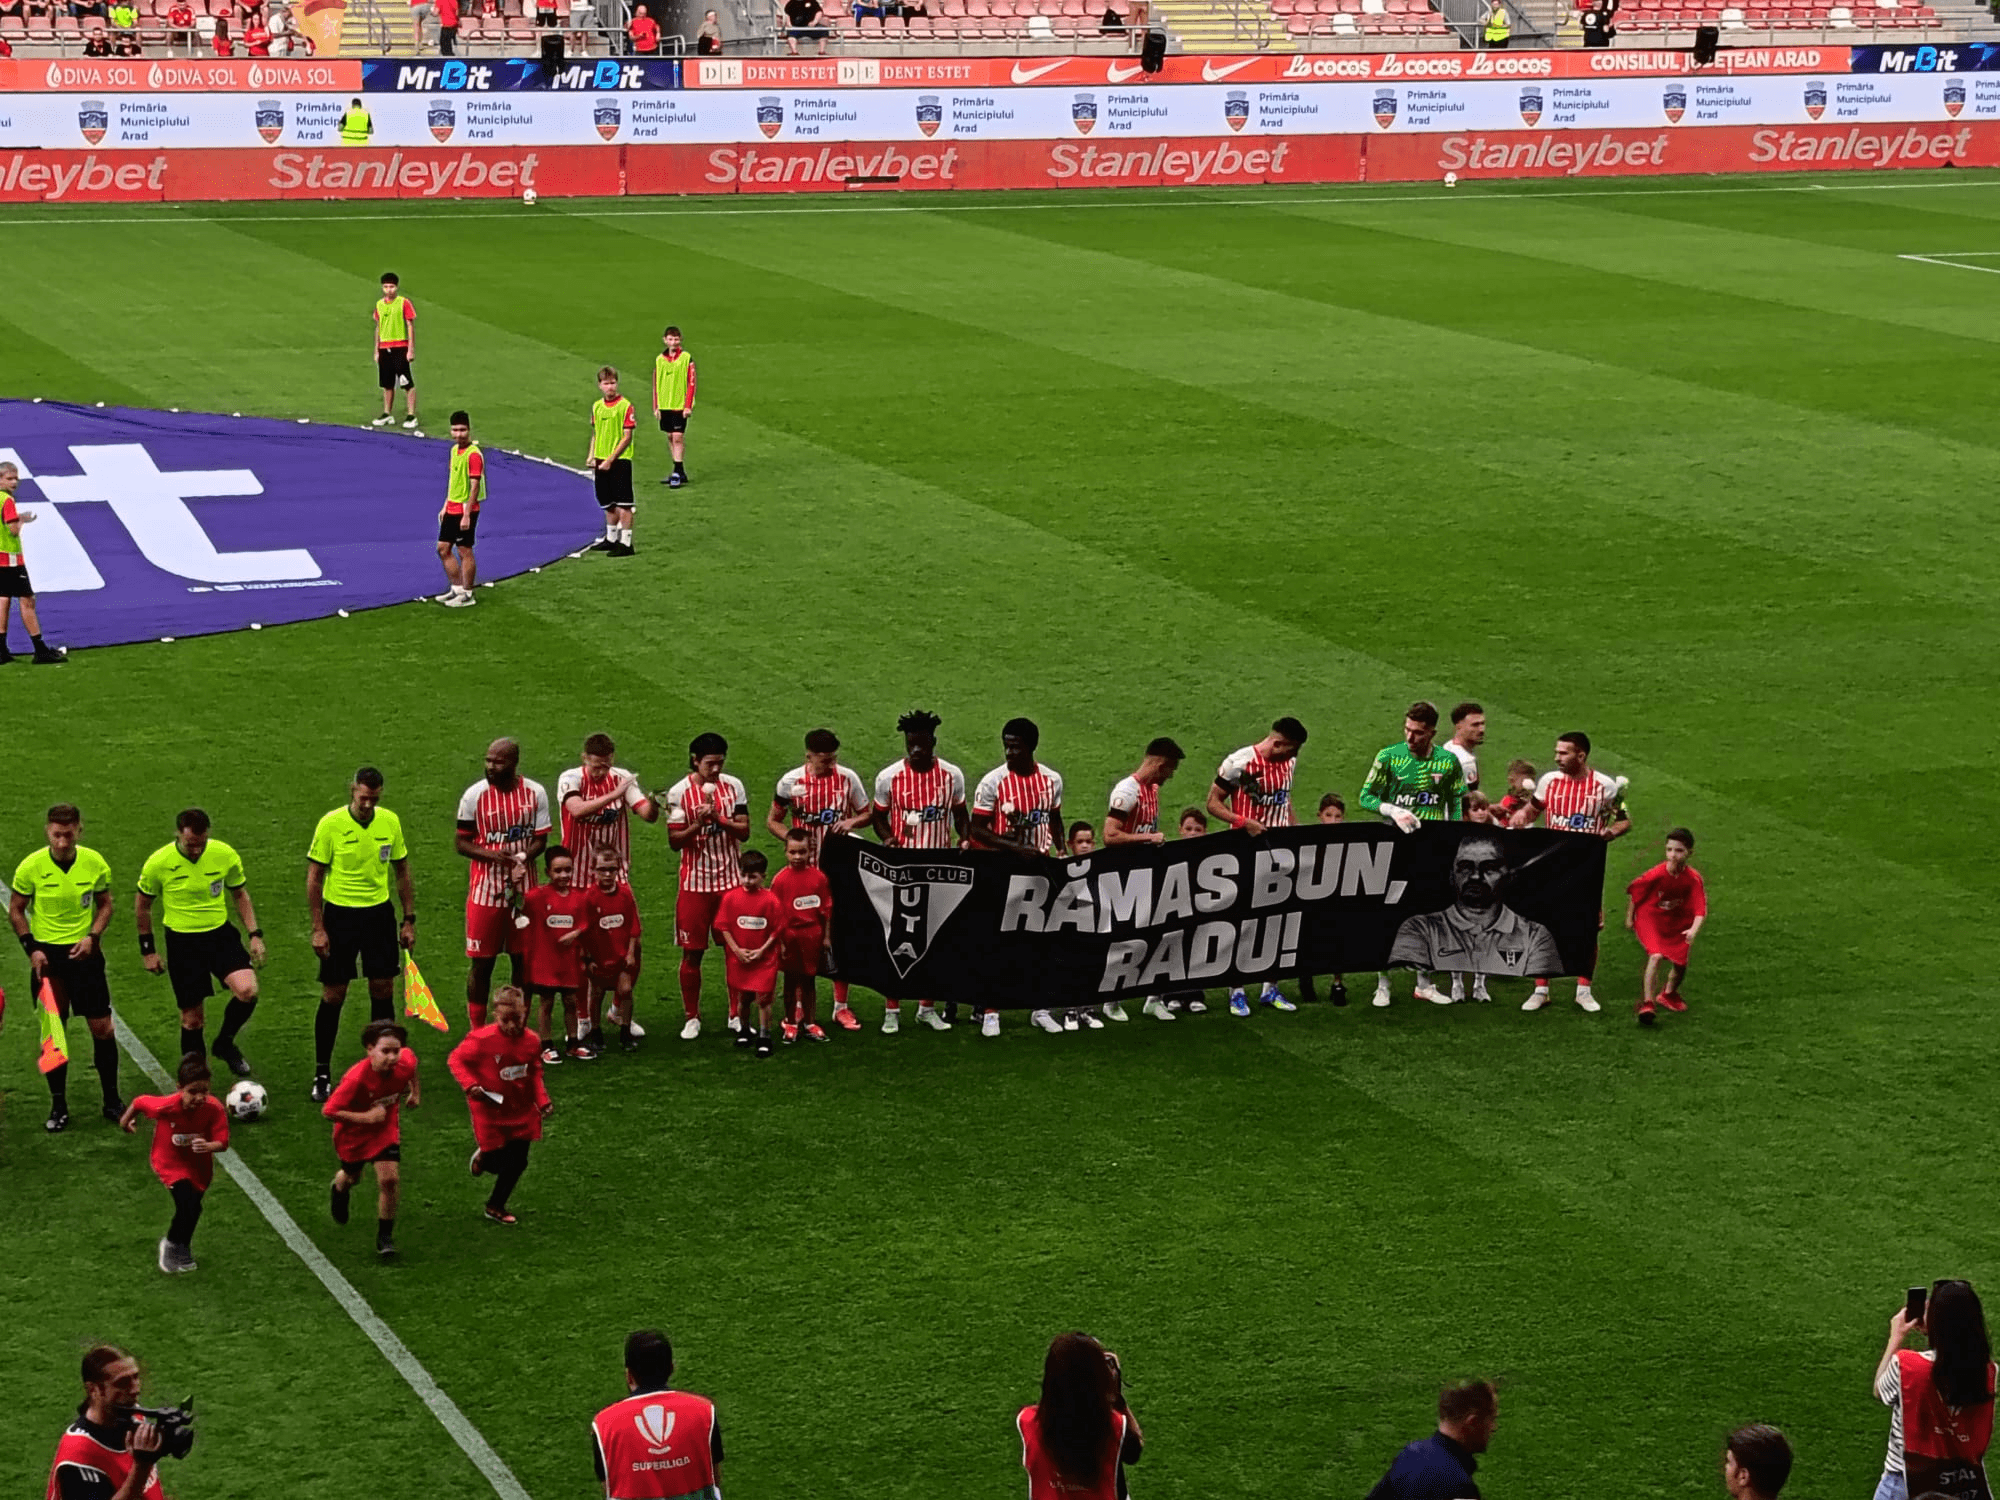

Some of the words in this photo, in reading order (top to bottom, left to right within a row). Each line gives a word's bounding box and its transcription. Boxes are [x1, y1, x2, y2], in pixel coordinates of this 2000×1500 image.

[1590, 53, 1680, 71] CONSILIUL
[1773, 50, 1820, 67] ARAD
[1879, 46, 1958, 72] MrBit
[64, 68, 102, 85] DIVA
[107, 68, 136, 85] SOL
[165, 68, 203, 85] DIVA
[208, 68, 237, 85] SOL
[265, 68, 302, 85] DIVA
[307, 68, 335, 85] SOL
[397, 60, 492, 90] MrBit
[552, 60, 644, 89] MrBit
[747, 66, 786, 80] DENT
[791, 66, 837, 80] ESTET
[884, 66, 923, 79] DENT
[927, 65, 971, 79] ESTET
[1975, 80, 2000, 89] Primă
[1553, 100, 1609, 111] Municipiului
[1696, 97, 1751, 108] Municipiului
[1836, 94, 1891, 105] Municipiului
[1108, 106, 1168, 118] Municipiului
[1259, 104, 1318, 116] Municipiului
[1407, 102, 1465, 113] Municipiului
[1837, 107, 1858, 116] Arad
[1975, 105, 1996, 114] Arad
[467, 114, 533, 126] Municipiului
[632, 112, 696, 124] Municipiului
[794, 111, 857, 123] Municipiului
[953, 109, 1014, 121] Municipiului
[1408, 116, 1430, 125] Arad
[1553, 113, 1575, 122] Arad
[1696, 110, 1718, 119] Arad
[121, 116, 190, 128] Municipiului
[296, 116, 339, 127] Municip
[1108, 120, 1132, 130] Arad
[1260, 118, 1283, 127] Arad
[468, 129, 493, 138] Arad
[633, 127, 658, 136] Arad
[795, 125, 819, 135] Arad
[953, 123, 977, 133] Arad
[121, 131, 148, 141] Arad
[297, 130, 323, 140] Arad
[1748, 127, 1972, 167] Stanleybet
[1438, 134, 1669, 175] Stanleybet
[704, 146, 958, 188] Stanleybet
[1047, 142, 1290, 183] Stanleybet
[268, 152, 539, 196] Stanleybet
[1395, 791, 1440, 806] MrBit
[1551, 814, 1595, 830] MrBit
[863, 856, 914, 882] FOTBAL
[926, 867, 969, 882] CLUB
[1000, 853, 1239, 934] RĂMAS
[1250, 841, 1408, 909] BUN,
[892, 886, 921, 960] UTA
[1098, 911, 1303, 993] RADU!
[631, 1456, 690, 1472] SUPERLIGA
